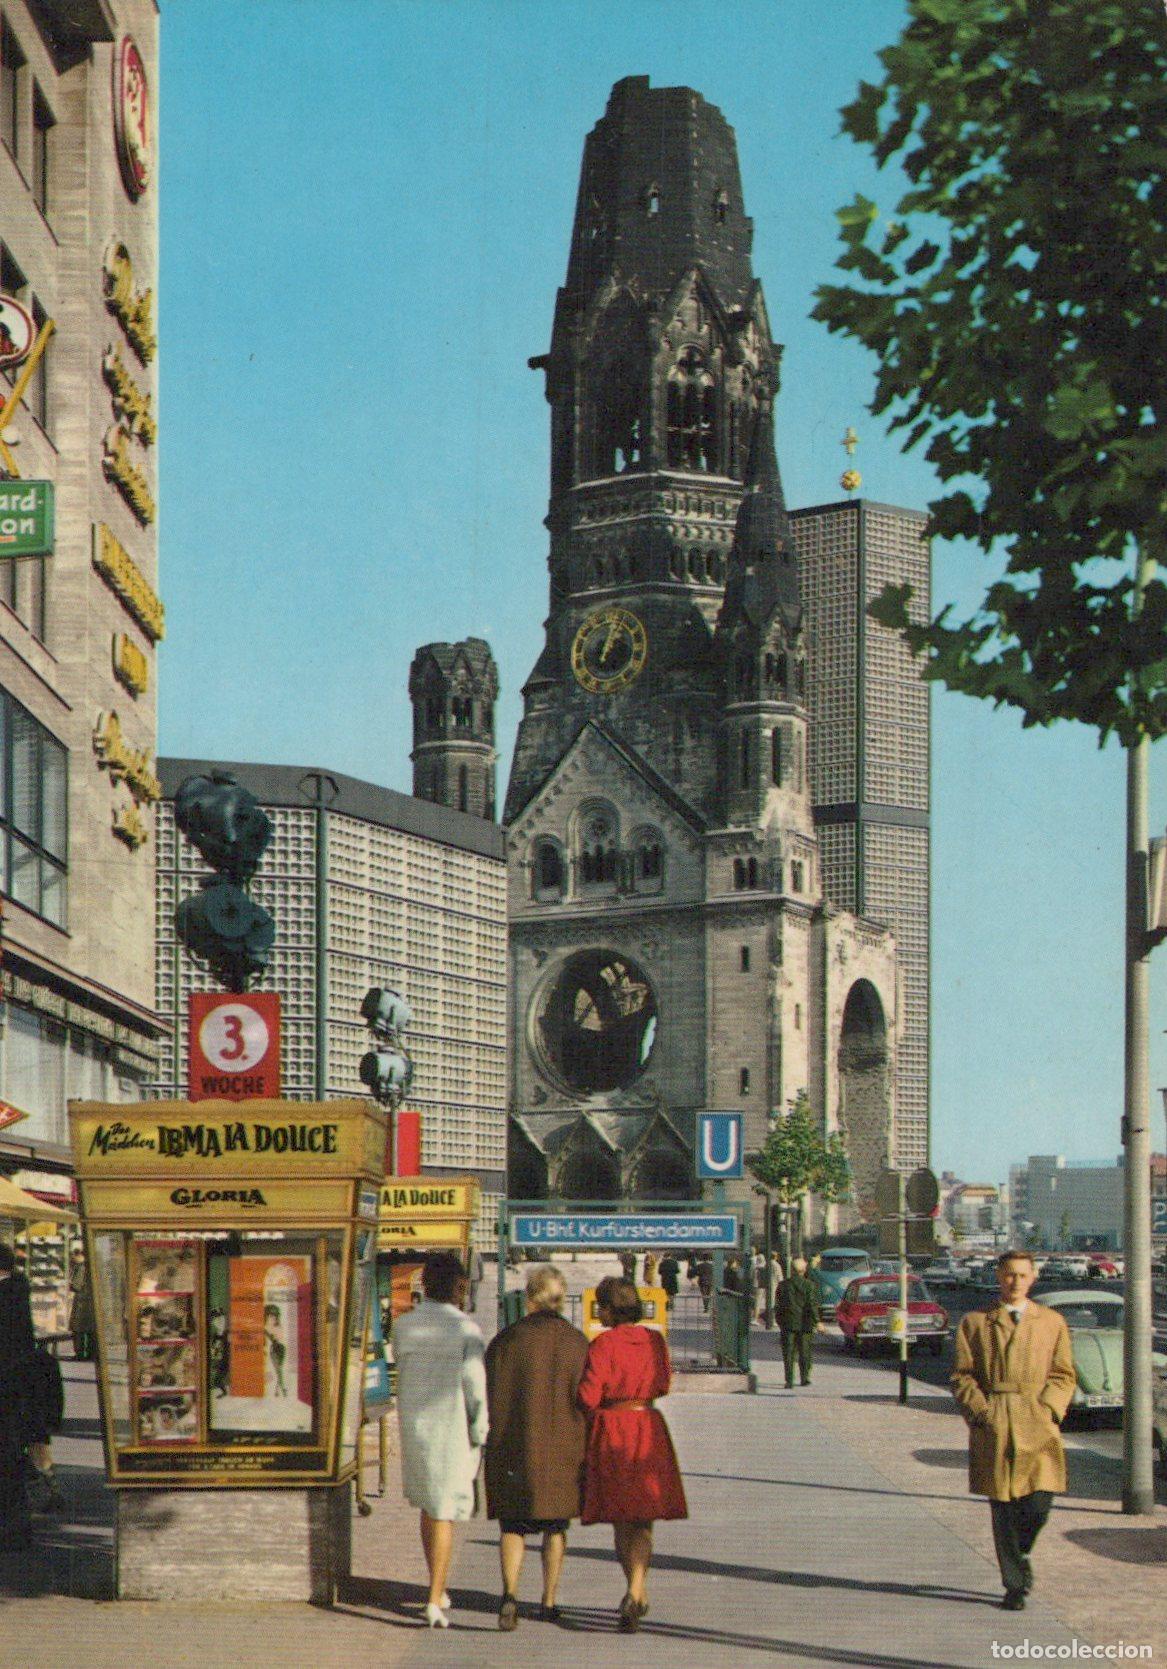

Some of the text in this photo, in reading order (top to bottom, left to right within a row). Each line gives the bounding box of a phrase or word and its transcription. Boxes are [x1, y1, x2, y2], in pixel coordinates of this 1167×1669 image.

[219, 1015, 248, 1060] 3.
[202, 1076, 264, 1094] WOCHE
[223, 1122, 250, 1150] LA
[253, 1124, 338, 1153] DOUCE
[704, 1120, 738, 1171] U
[170, 1187, 267, 1208] GLORIA
[409, 1189, 455, 1206] DOUCE
